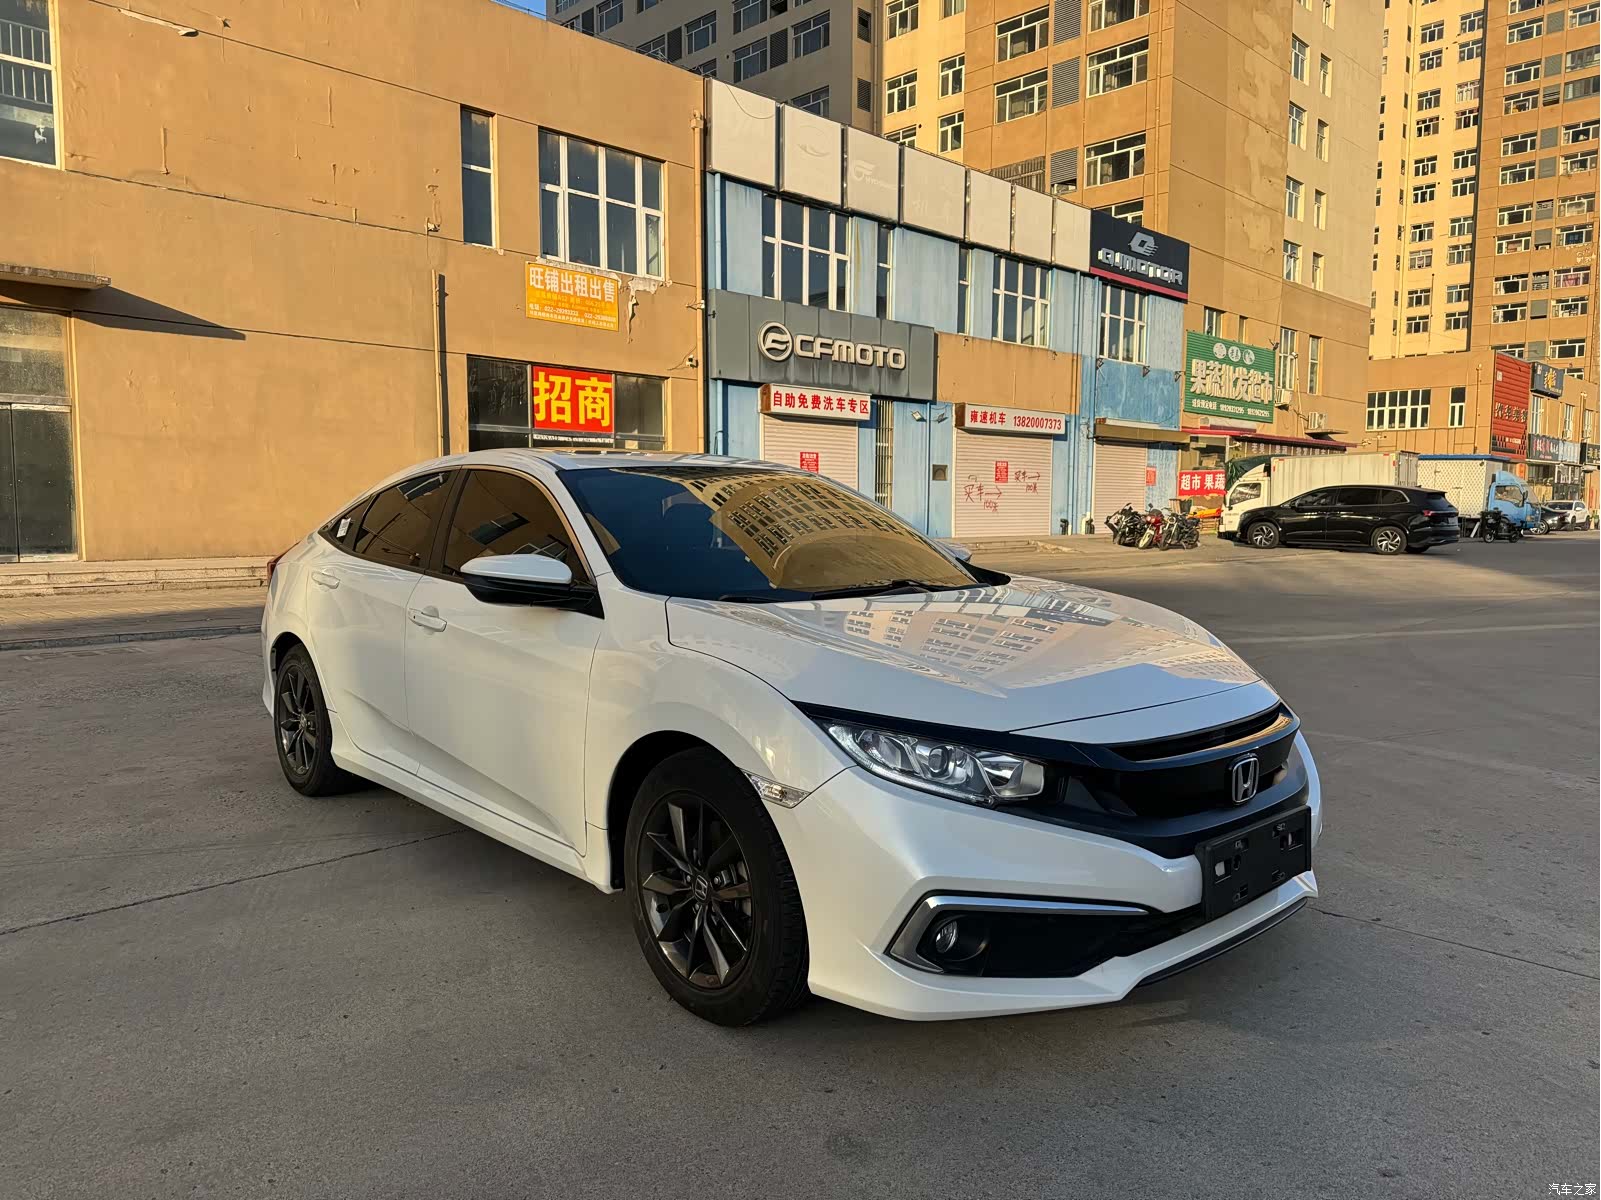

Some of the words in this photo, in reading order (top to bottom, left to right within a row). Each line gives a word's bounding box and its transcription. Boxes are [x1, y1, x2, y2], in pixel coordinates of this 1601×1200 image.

[529, 267, 615, 303] 旺铺出租出售
[794, 334, 906, 370] CFMOTO
[533, 371, 612, 427] 招商
[1190, 358, 1274, 405] 果蔬批发超市
[773, 390, 869, 414] 自助免费洗车专区
[970, 409, 1007, 425] 雍速机车
[1013, 415, 1062, 430] 13820007373
[1180, 473, 1201, 491] 超市
[1203, 473, 1225, 491] 果蔬
